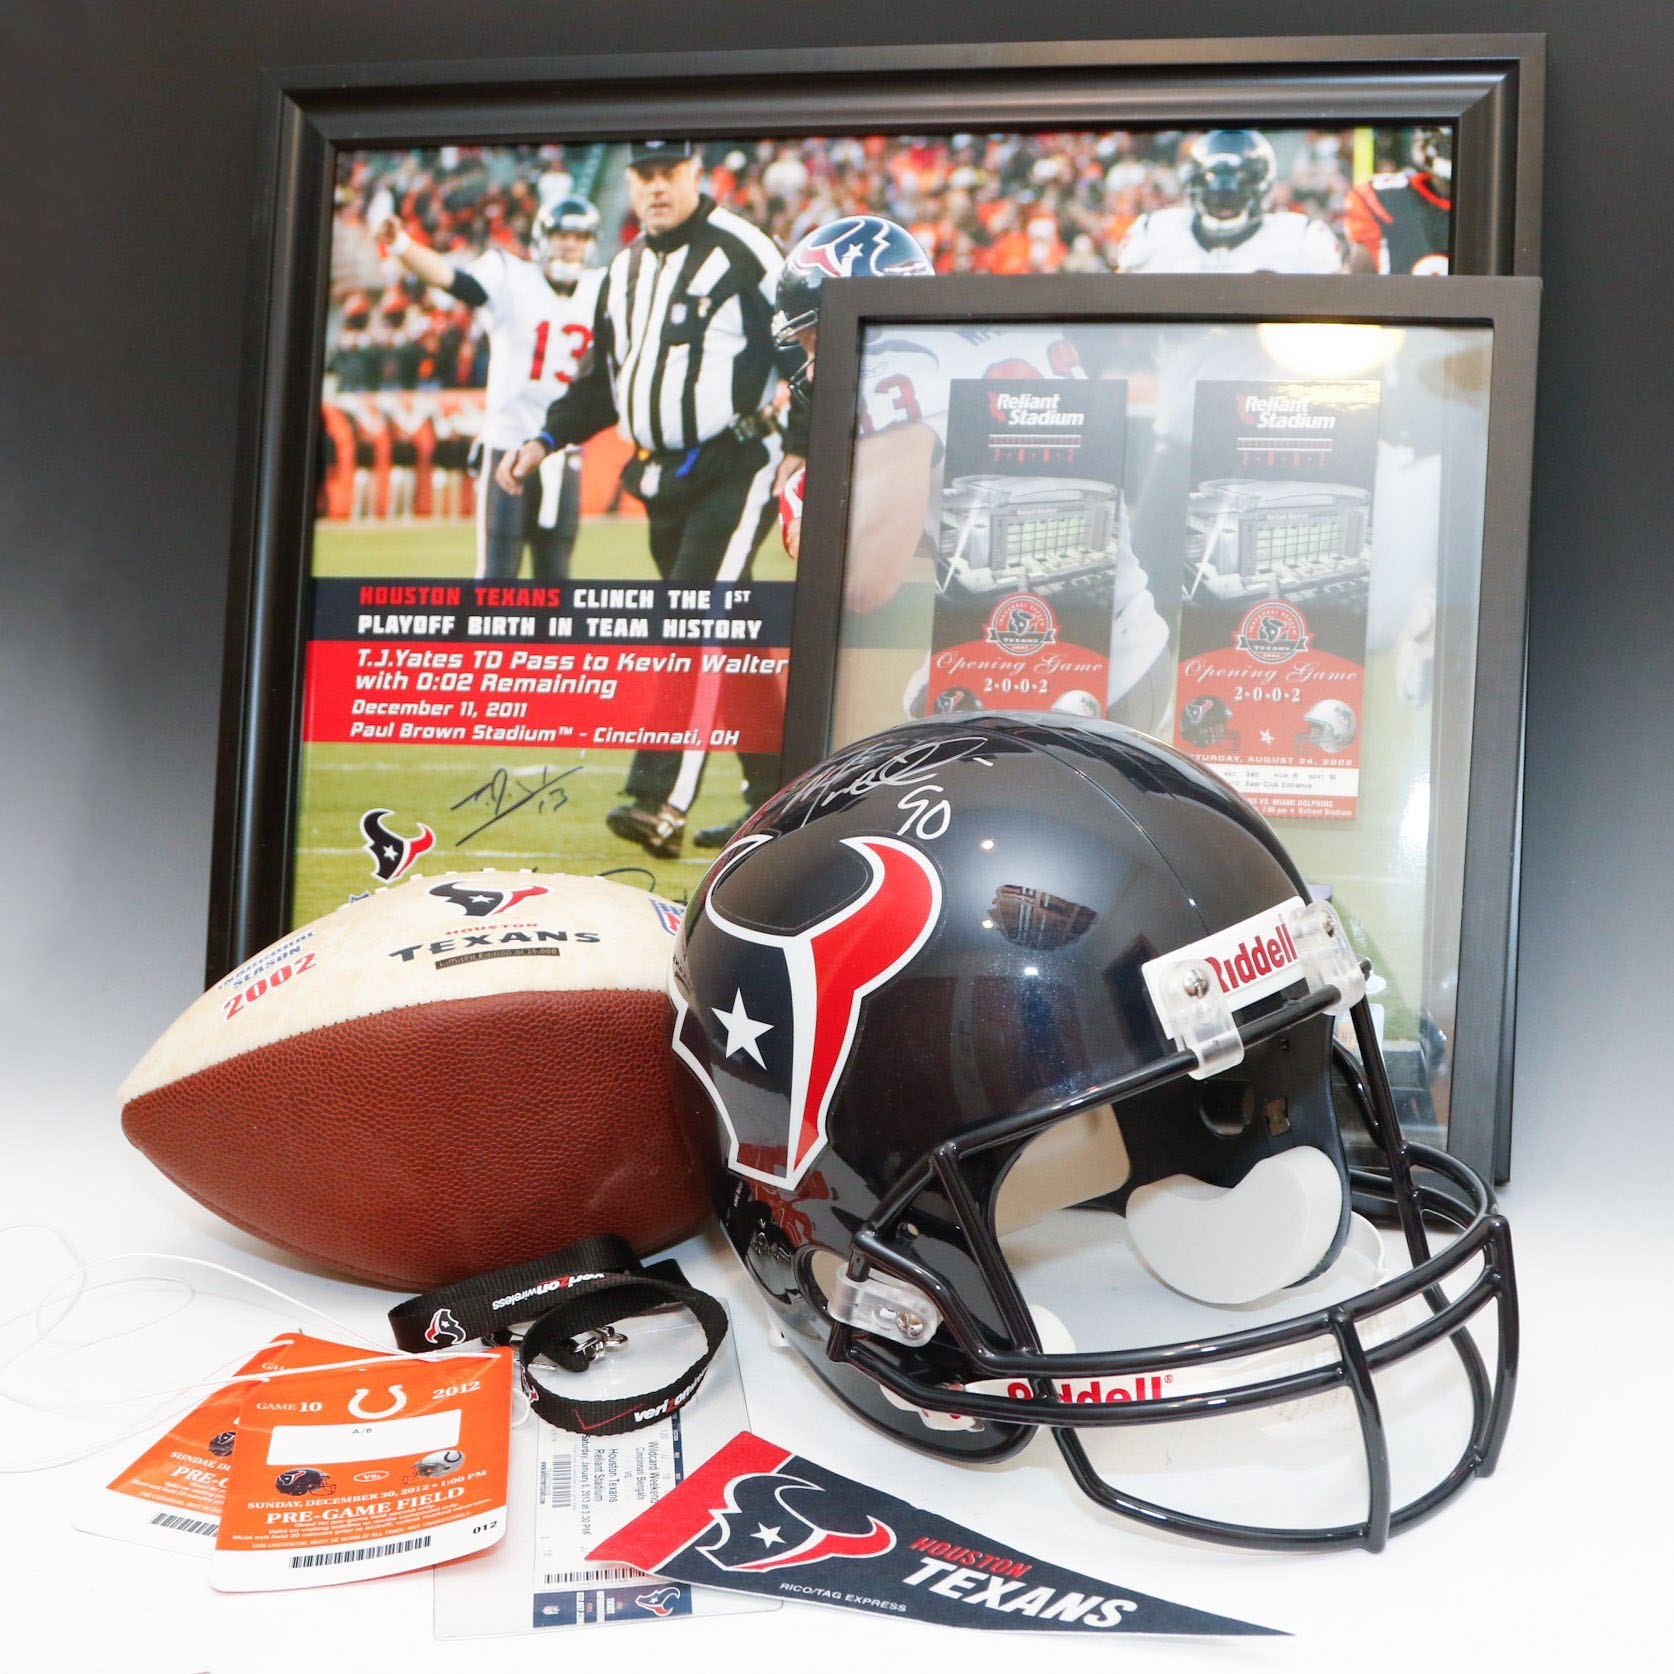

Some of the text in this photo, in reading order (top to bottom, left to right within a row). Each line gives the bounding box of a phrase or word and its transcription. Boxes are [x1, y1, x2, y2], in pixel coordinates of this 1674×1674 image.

[530, 320, 594, 384] 13
[997, 393, 1060, 409] Reliant
[1245, 396, 1310, 412] Reliant
[1008, 409, 1085, 426] Stadium
[1257, 412, 1336, 429] Stadium
[359, 586, 751, 610] HOUSTON TEXANS CLINCH THE 1ST
[357, 614, 763, 640] PLAYOFF BIRTH IN TEAM HISTORY
[357, 648, 788, 675] T.J.Yates TD Pass to Kevin Walter
[936, 651, 1103, 677] Opening Game
[1184, 659, 1358, 685] Opening Game
[356, 671, 618, 699] with 0:02 Remaining
[351, 699, 527, 719] December 11, 2011
[350, 722, 394, 738] Paul
[400, 722, 466, 740] Brown
[593, 727, 702, 747] Cincinnati,
[709, 729, 740, 746] OH
[897, 785, 951, 840] 90
[1297, 798, 1334, 808] DOLPHINS
[445, 923, 538, 935] HOUSTON
[388, 931, 601, 962] TEXANS
[223, 952, 317, 1020] 2002
[432, 1380, 481, 1400] 2012
[256, 1402, 323, 1412] GAME 10
[169, 1451, 215, 1469] SUNDAY,
[580, 1461, 590, 1483] January
[648, 1441, 661, 1504] Wildcard Weekend
[594, 1449, 605, 1502] Reliant Stadium
[608, 1448, 620, 1503] Houston Texans
[635, 1447, 646, 1501] Cincinnati Bengals
[248, 1469, 488, 1509] SUNDAY, DECEMBER 30, 2012 1:00 PM
[265, 1487, 465, 1525] PRE-GAME FIELD
[472, 1520, 498, 1535] 012
[908, 1535, 1033, 1579] HOUSTON
[779, 1582, 908, 1614] RICO/TAG EXPRESS
[902, 1556, 1138, 1629] TEXANS
